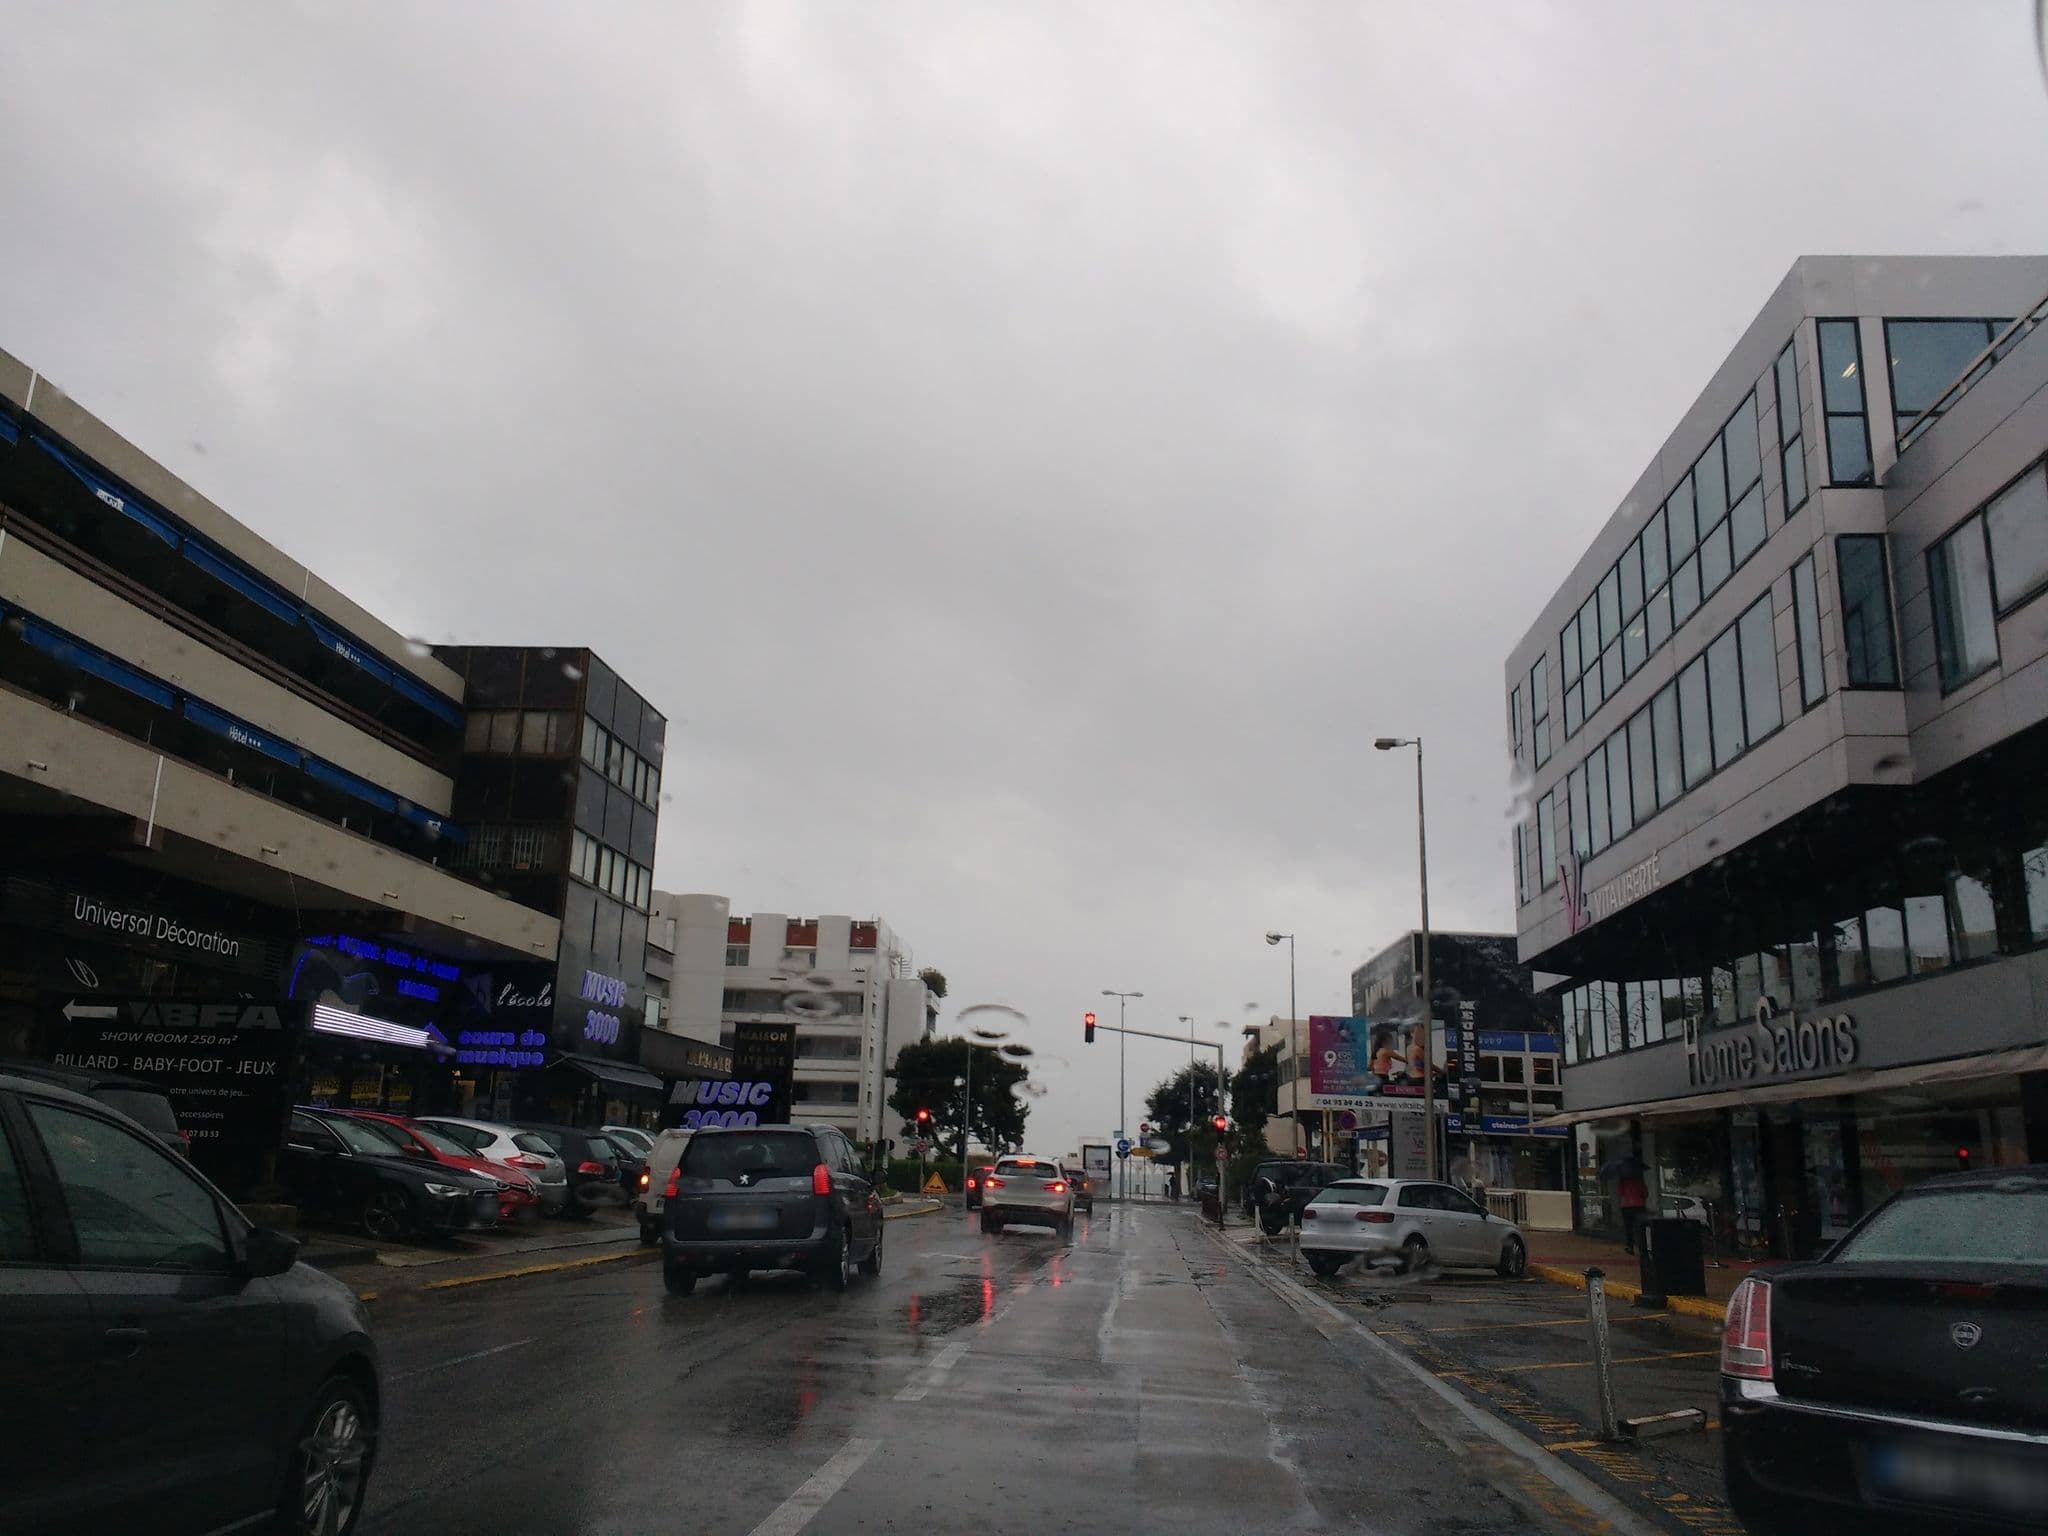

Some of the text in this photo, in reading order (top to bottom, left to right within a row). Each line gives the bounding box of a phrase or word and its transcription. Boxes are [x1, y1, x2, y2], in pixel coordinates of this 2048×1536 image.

[229, 725, 248, 745] Hôtel
[73, 895, 240, 958] Universal Décoration
[581, 969, 627, 1008] MUSIC
[99, 1031, 143, 1043] SHOW
[144, 1032, 188, 1045] ROOM
[190, 1034, 217, 1046] 250
[519, 1028, 546, 1047] de
[584, 1009, 620, 1046] 3000
[1458, 1000, 1477, 1073] MEUBLES
[1683, 995, 1857, 1087] Home Salons
[55, 1053, 119, 1070] BILLARD
[133, 1056, 224, 1074] BABY-FOOT
[235, 1060, 277, 1077] JEUX
[669, 1081, 773, 1106] MUSIC
